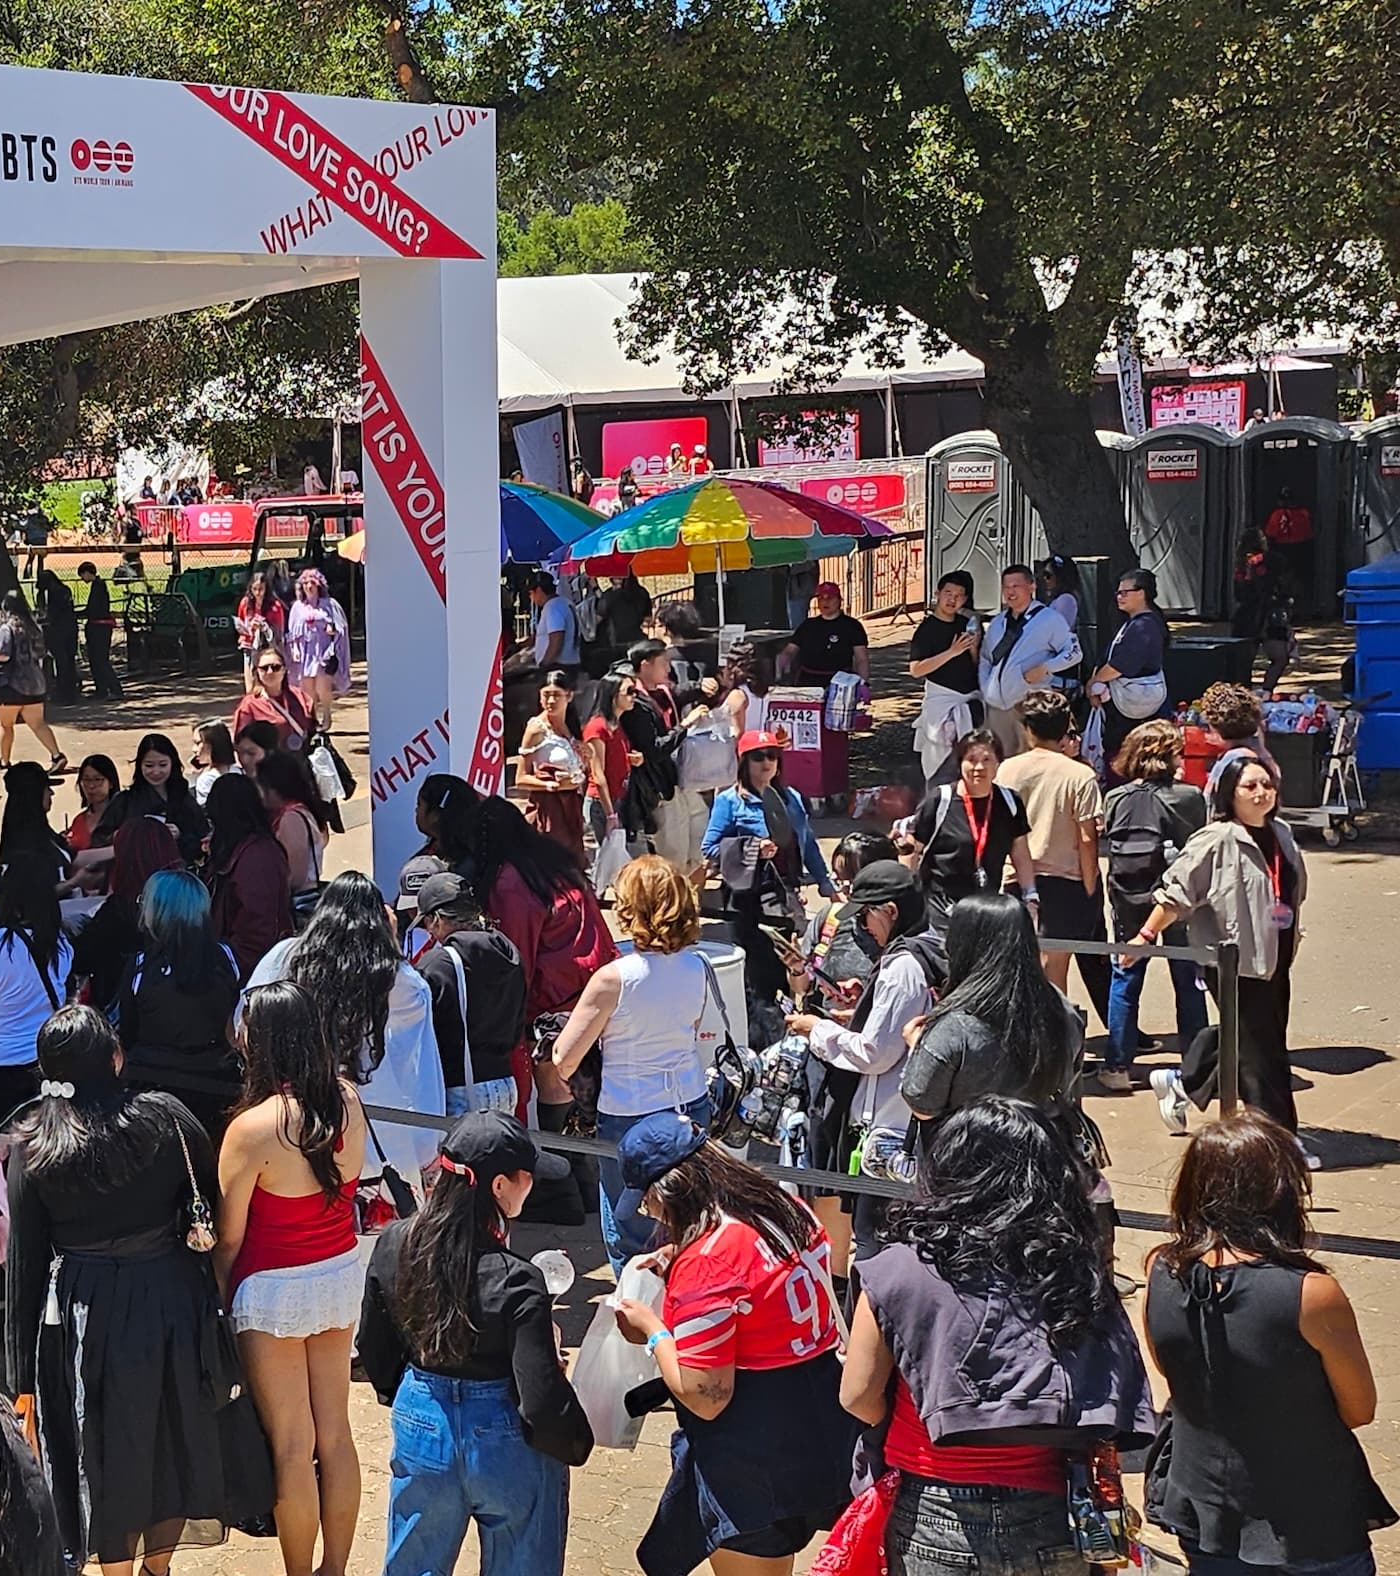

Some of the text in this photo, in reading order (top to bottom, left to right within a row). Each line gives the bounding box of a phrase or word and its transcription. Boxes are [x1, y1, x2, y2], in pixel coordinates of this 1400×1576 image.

[434, 107, 490, 148] LOV
[1, 132, 57, 183] BTS
[272, 113, 342, 189] LOVE
[342, 166, 429, 254] SONG?
[359, 366, 391, 421] AT
[372, 419, 407, 464] IS
[1158, 454, 1196, 463] ROCKET
[957, 465, 993, 474] ROCKET
[875, 548, 922, 598] EXT
